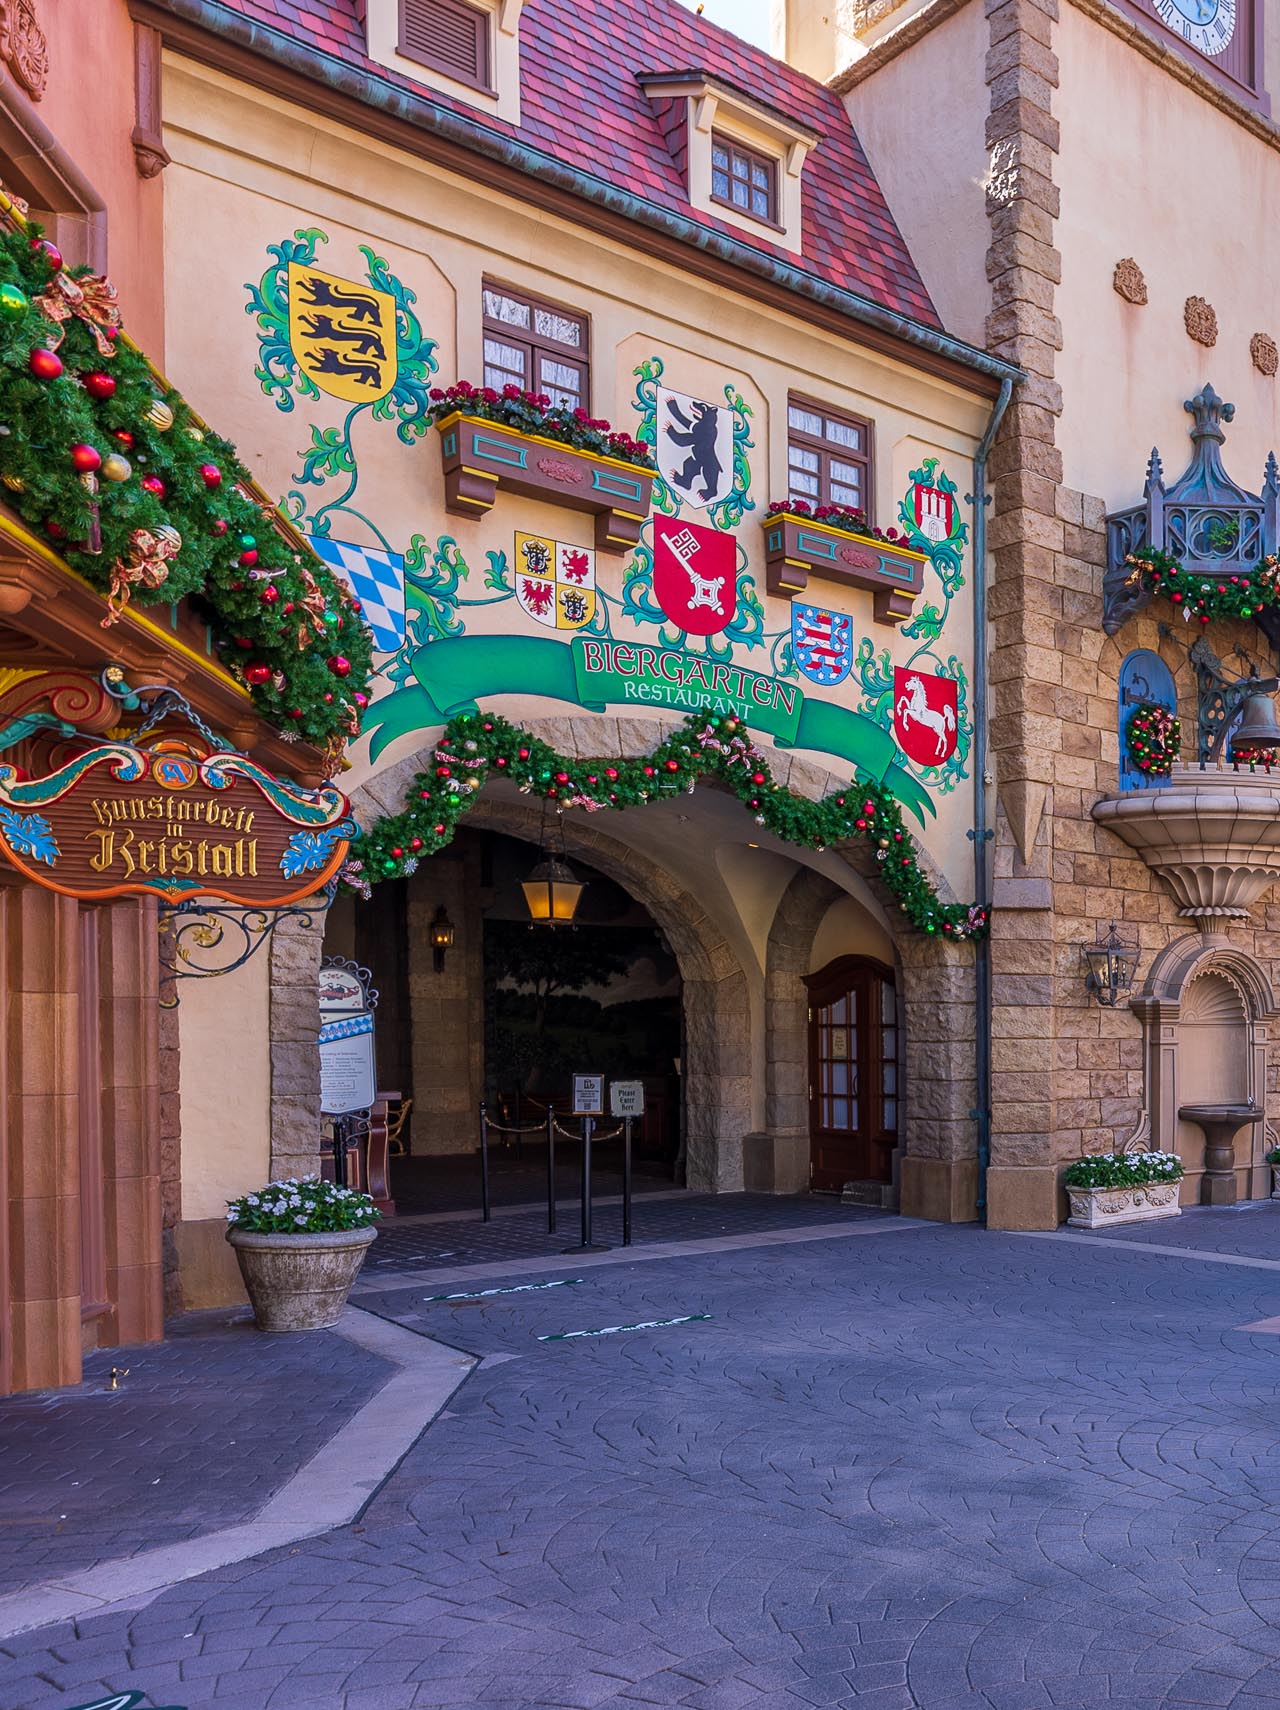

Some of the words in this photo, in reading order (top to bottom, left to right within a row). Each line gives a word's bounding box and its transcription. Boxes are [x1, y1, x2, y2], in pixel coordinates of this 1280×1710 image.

[583, 641, 797, 715] BIERGARTEN
[623, 681, 753, 720] RESTAURANT
[91, 795, 254, 833] Kunstarbeit
[166, 819, 183, 837] in
[84, 828, 258, 879] Kristall
